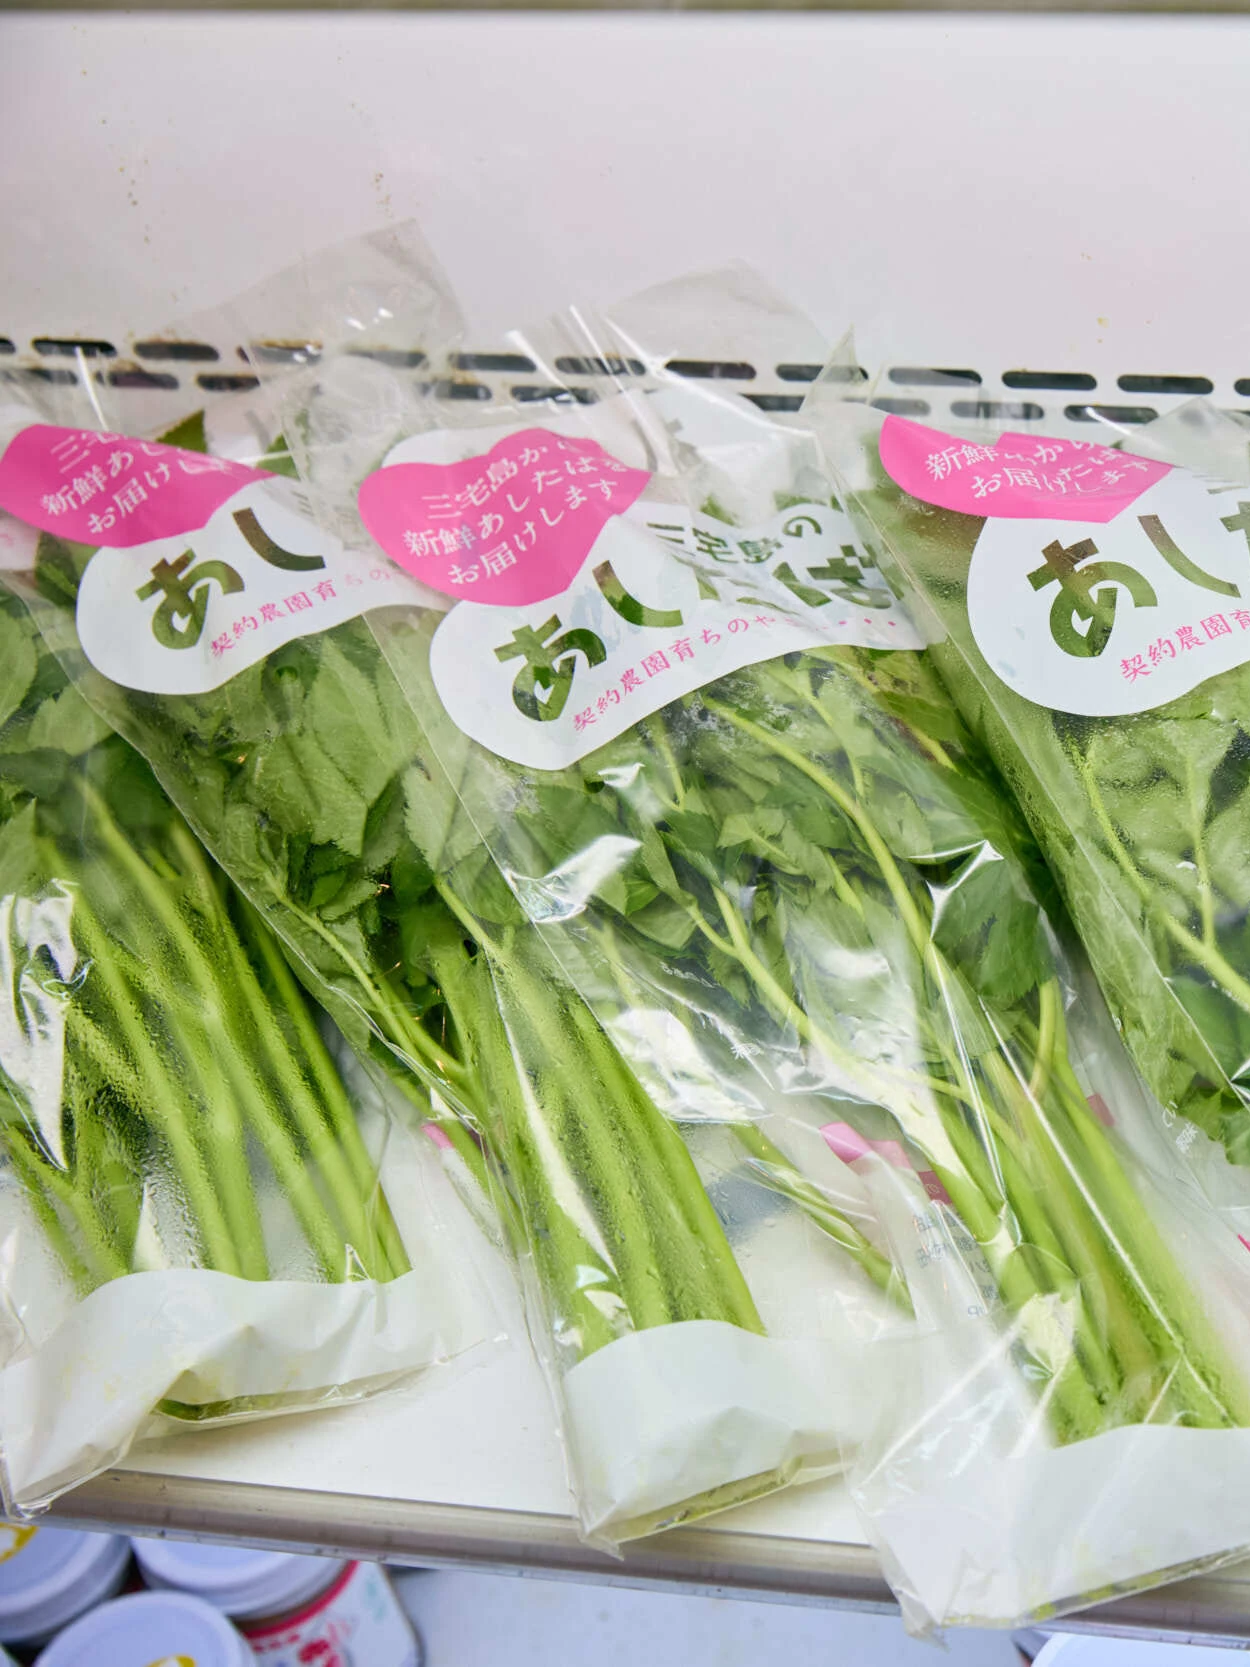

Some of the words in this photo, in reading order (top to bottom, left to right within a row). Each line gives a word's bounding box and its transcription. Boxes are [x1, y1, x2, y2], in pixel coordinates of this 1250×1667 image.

[135, 507, 326, 650] あし
[448, 479, 617, 585] お届けします
